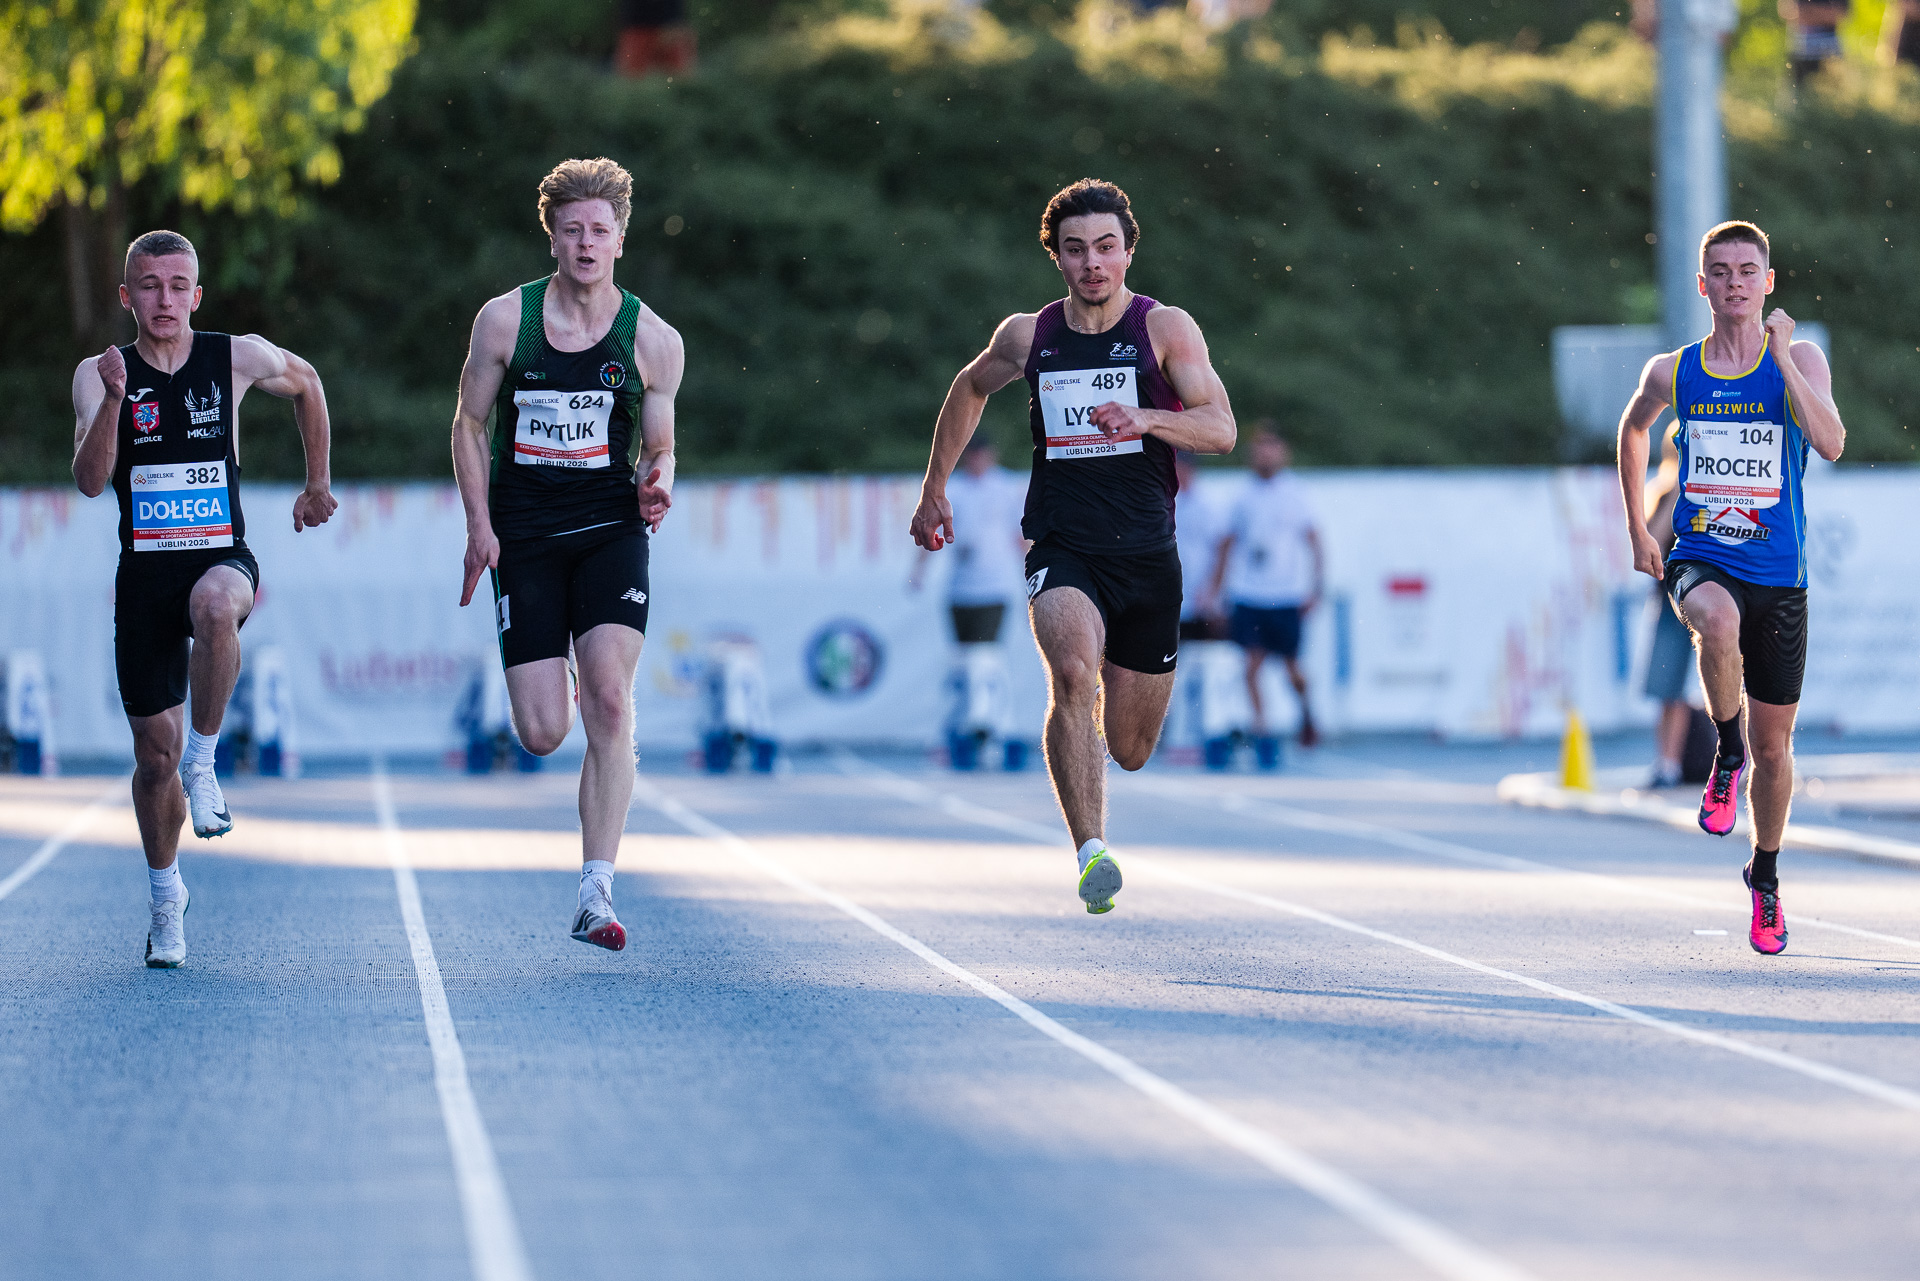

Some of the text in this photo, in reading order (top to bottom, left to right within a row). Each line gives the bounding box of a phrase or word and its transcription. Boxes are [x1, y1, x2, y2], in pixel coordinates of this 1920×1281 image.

[1092, 372, 1126, 390] 489
[569, 395, 604, 410] 624
[1690, 402, 1764, 415] KRUSZWICA
[190, 406, 220, 418] FENIKS
[192, 414, 220, 424] SIEDLCE
[530, 419, 595, 442] PYTLIK
[1740, 428, 1774, 445] 104
[134, 436, 162, 445] SIEDLCE
[1095, 445, 1116, 453] 2026
[1695, 456, 1772, 478] PROCEK
[186, 467, 220, 484] 382
[139, 498, 223, 522] DOŁĘGA
